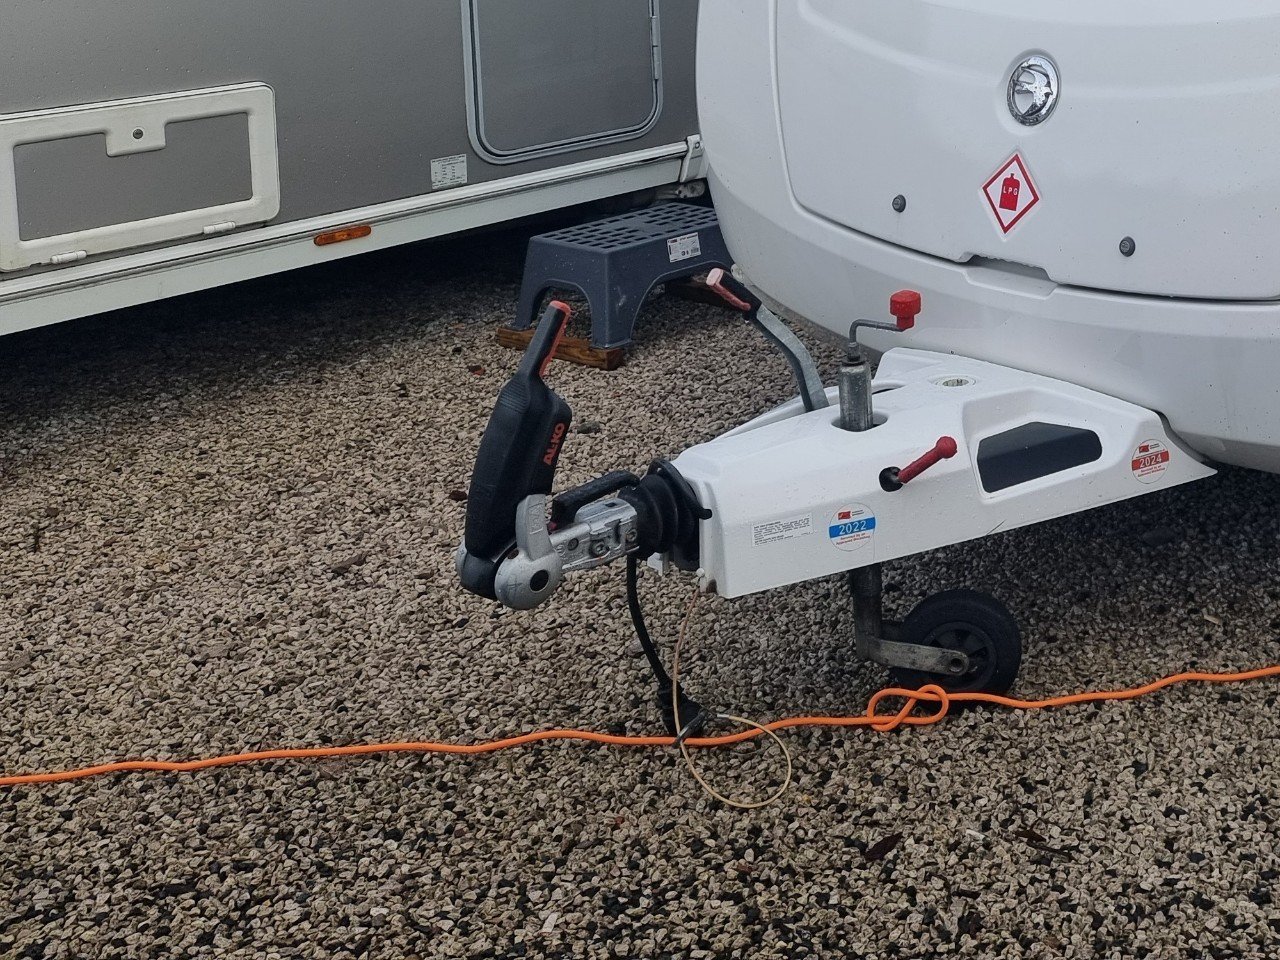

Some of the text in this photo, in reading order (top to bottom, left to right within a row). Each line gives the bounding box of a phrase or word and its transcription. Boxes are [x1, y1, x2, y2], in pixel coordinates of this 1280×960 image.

[1003, 186, 1018, 196] LPG
[1140, 454, 1162, 468] 2024
[839, 520, 867, 535] 2022
